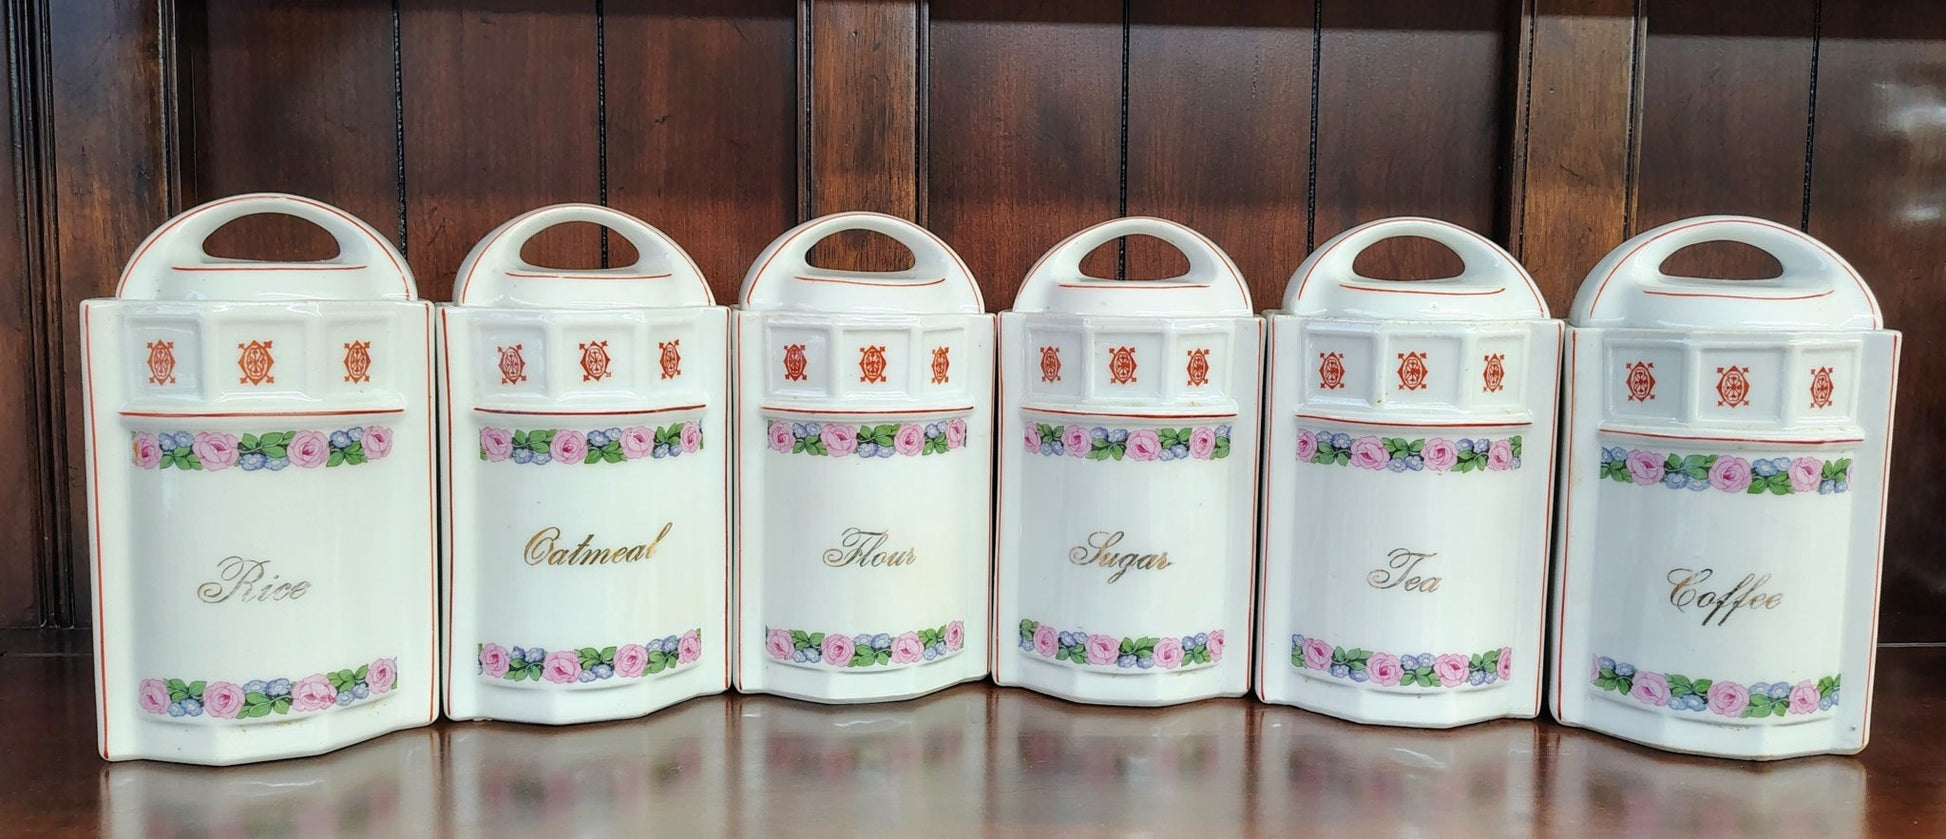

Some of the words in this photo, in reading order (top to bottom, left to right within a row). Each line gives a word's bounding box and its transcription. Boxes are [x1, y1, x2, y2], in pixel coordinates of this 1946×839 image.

[523, 522, 673, 567] Oatmeal
[822, 527, 917, 568] Flour
[1068, 531, 1174, 585] Sugar
[197, 555, 312, 604] Rice
[1366, 548, 1443, 594] Tea
[1666, 568, 1785, 627] Coffee
